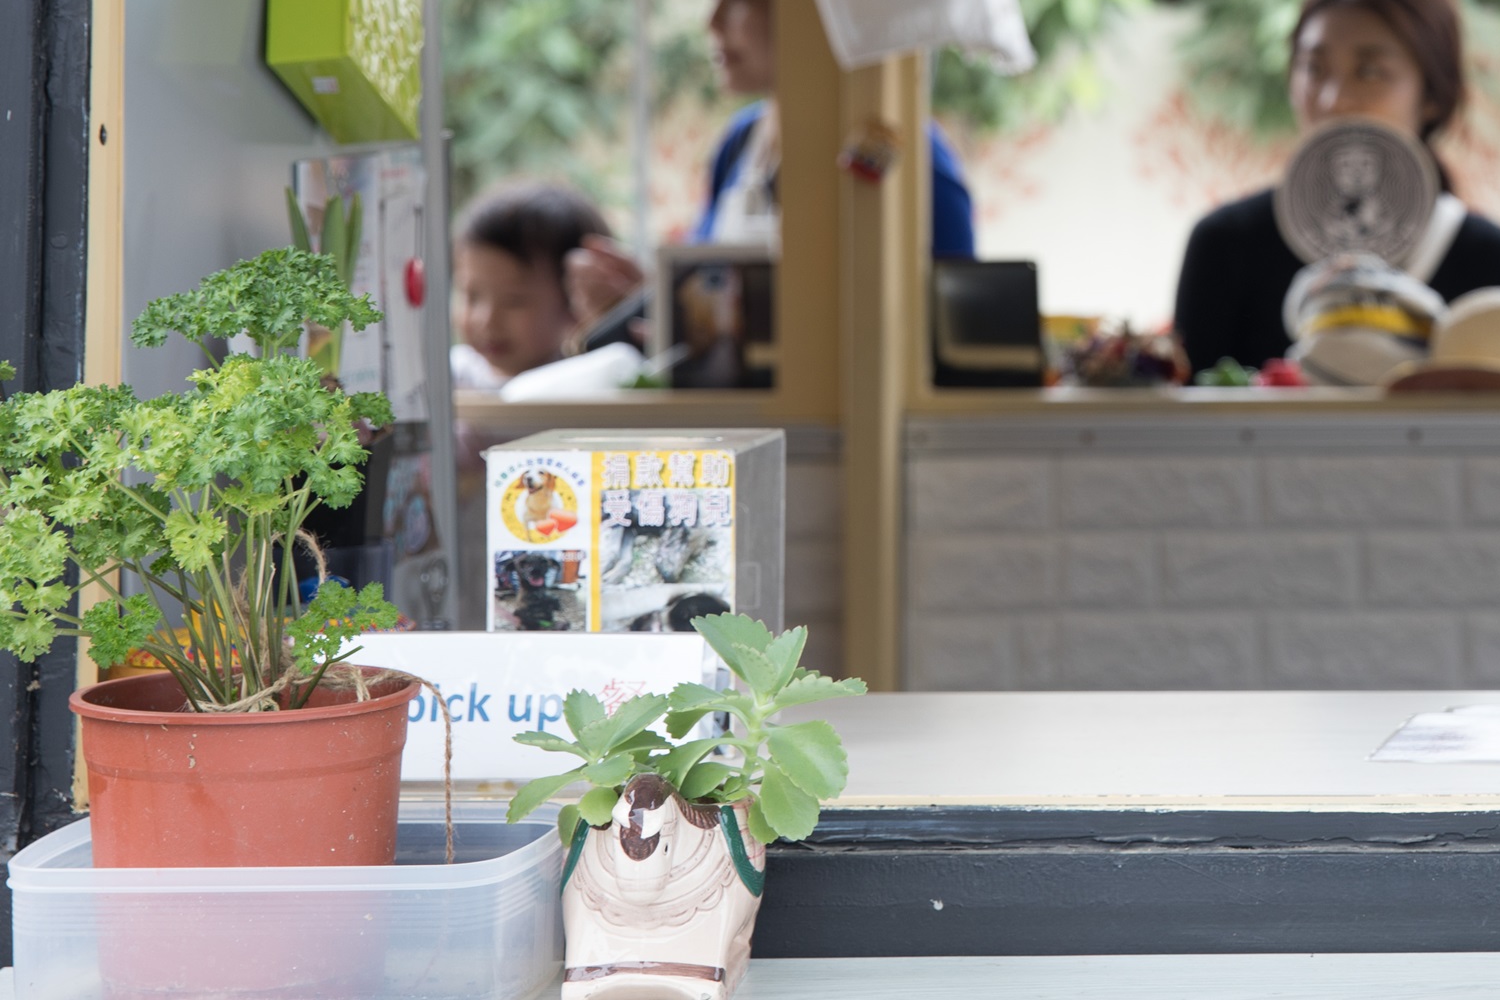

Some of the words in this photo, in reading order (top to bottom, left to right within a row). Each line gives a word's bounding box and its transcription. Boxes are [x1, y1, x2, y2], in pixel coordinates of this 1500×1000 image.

[601, 452, 730, 488] 捐款幫助
[600, 488, 731, 527] 受傷狗兒
[508, 692, 563, 731] up
